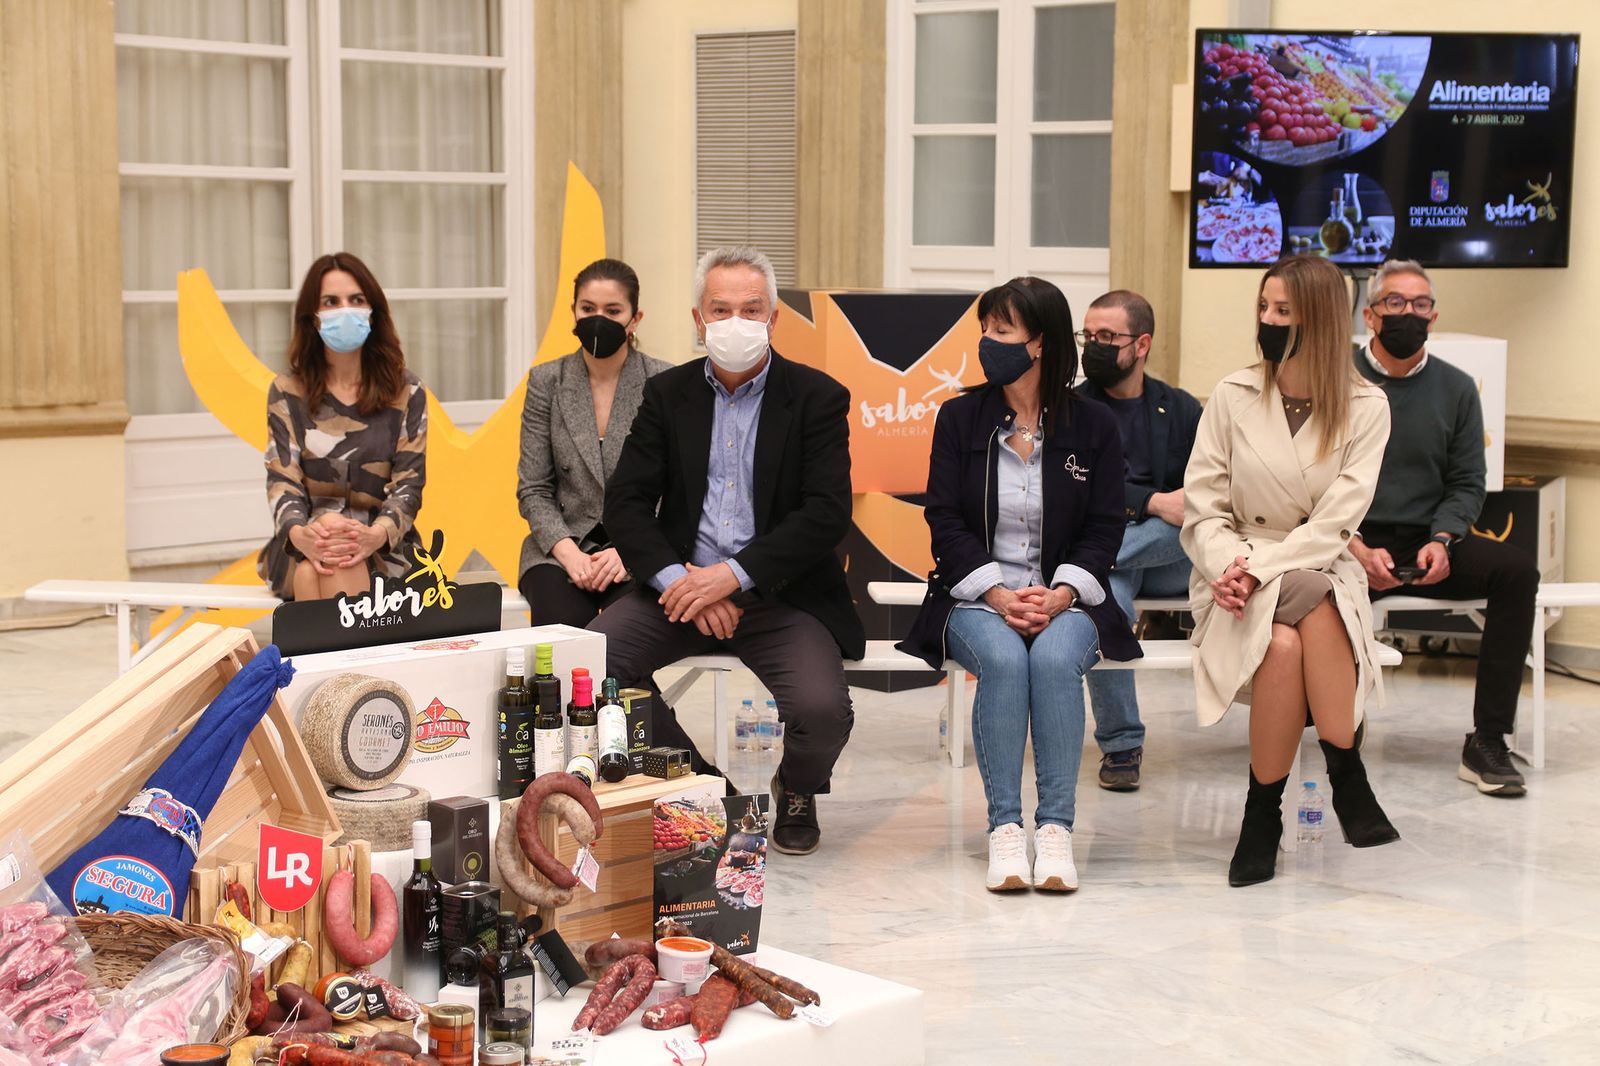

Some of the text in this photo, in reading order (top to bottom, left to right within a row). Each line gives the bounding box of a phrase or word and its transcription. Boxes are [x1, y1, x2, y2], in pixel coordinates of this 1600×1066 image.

[1428, 80, 1551, 102] Alimentaria
[1474, 115, 1500, 124] ABRIL
[1502, 115, 1525, 124] 2022
[1409, 205, 1468, 216] DIPUTACIÓN
[1410, 217, 1467, 226] DE ALMERÍA
[860, 387, 941, 428] sabor
[877, 425, 929, 437] ALMERÍA
[338, 577, 457, 628] sabores
[359, 615, 403, 628] ALMERÍA
[428, 721, 464, 734] EMILIO
[116, 862, 156, 882] JAMONES
[267, 846, 313, 888] LR
[86, 866, 166, 910] SEGURA
[659, 900, 716, 913] ALIMENTARIA
